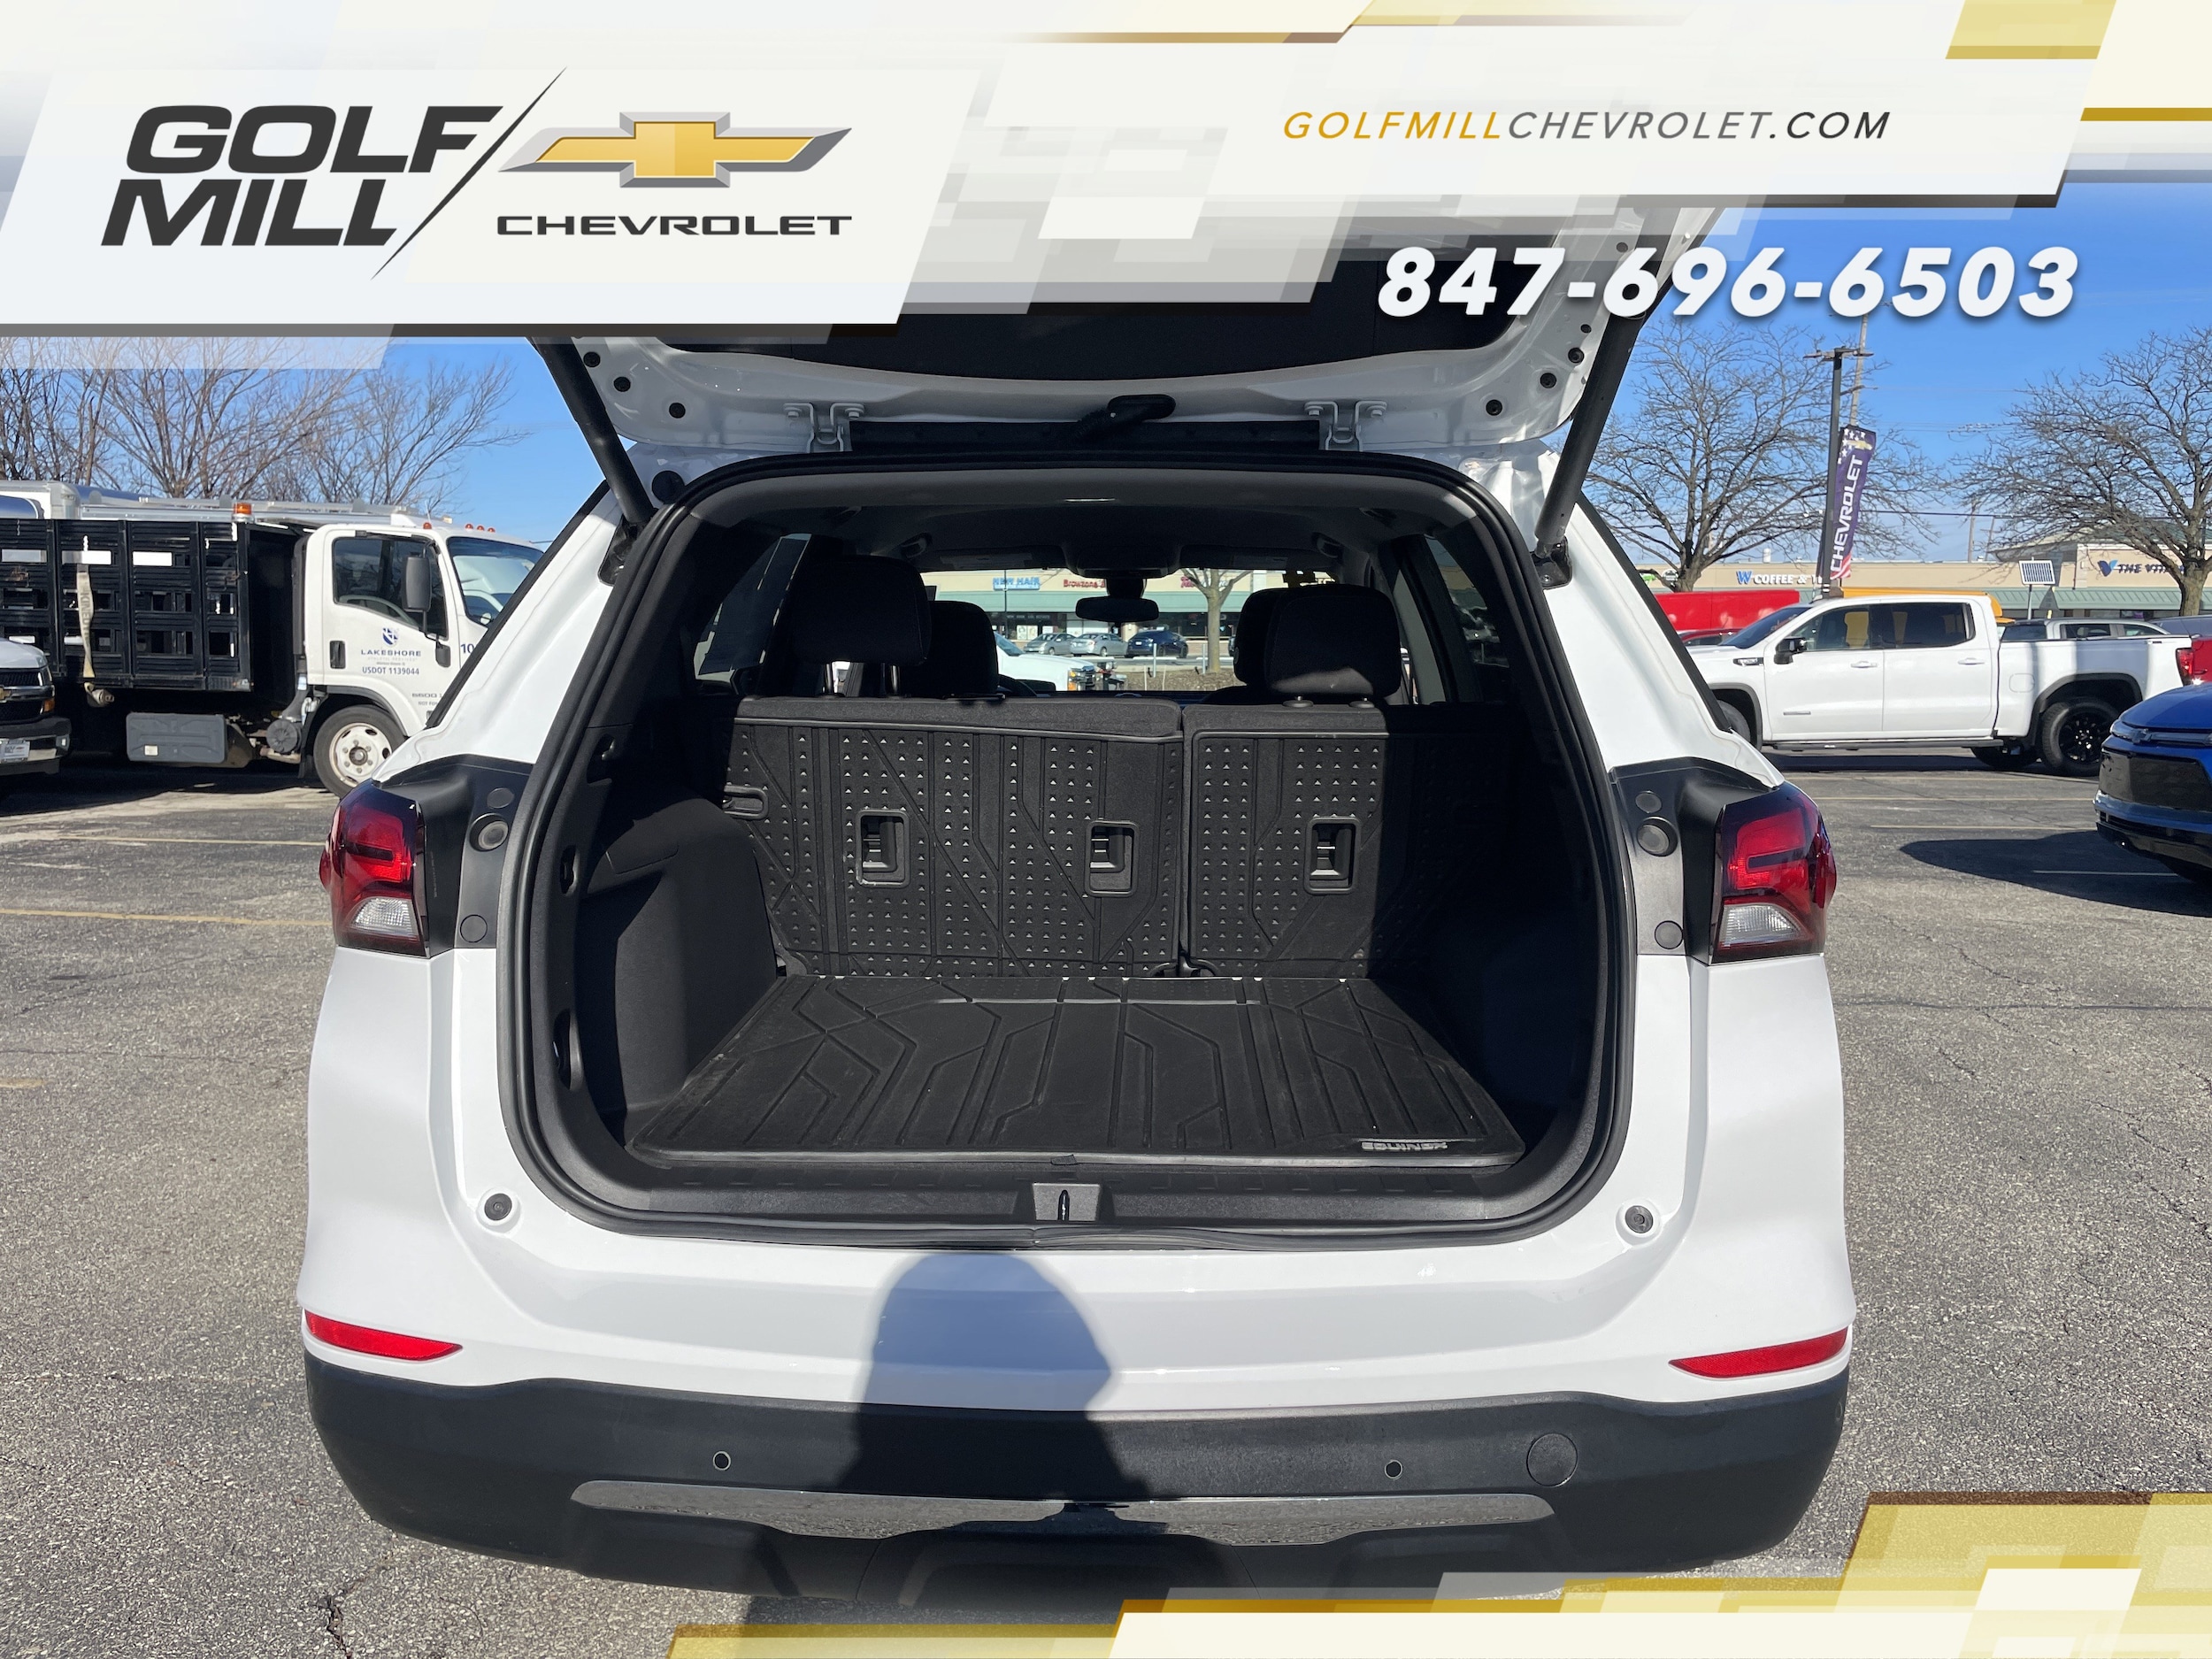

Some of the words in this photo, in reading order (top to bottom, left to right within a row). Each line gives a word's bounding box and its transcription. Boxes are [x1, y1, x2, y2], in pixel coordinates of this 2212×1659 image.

[1831, 455, 1863, 572] CHEVROLET
[1754, 574, 1793, 584] COFFEE
[1797, 574, 1807, 584] &
